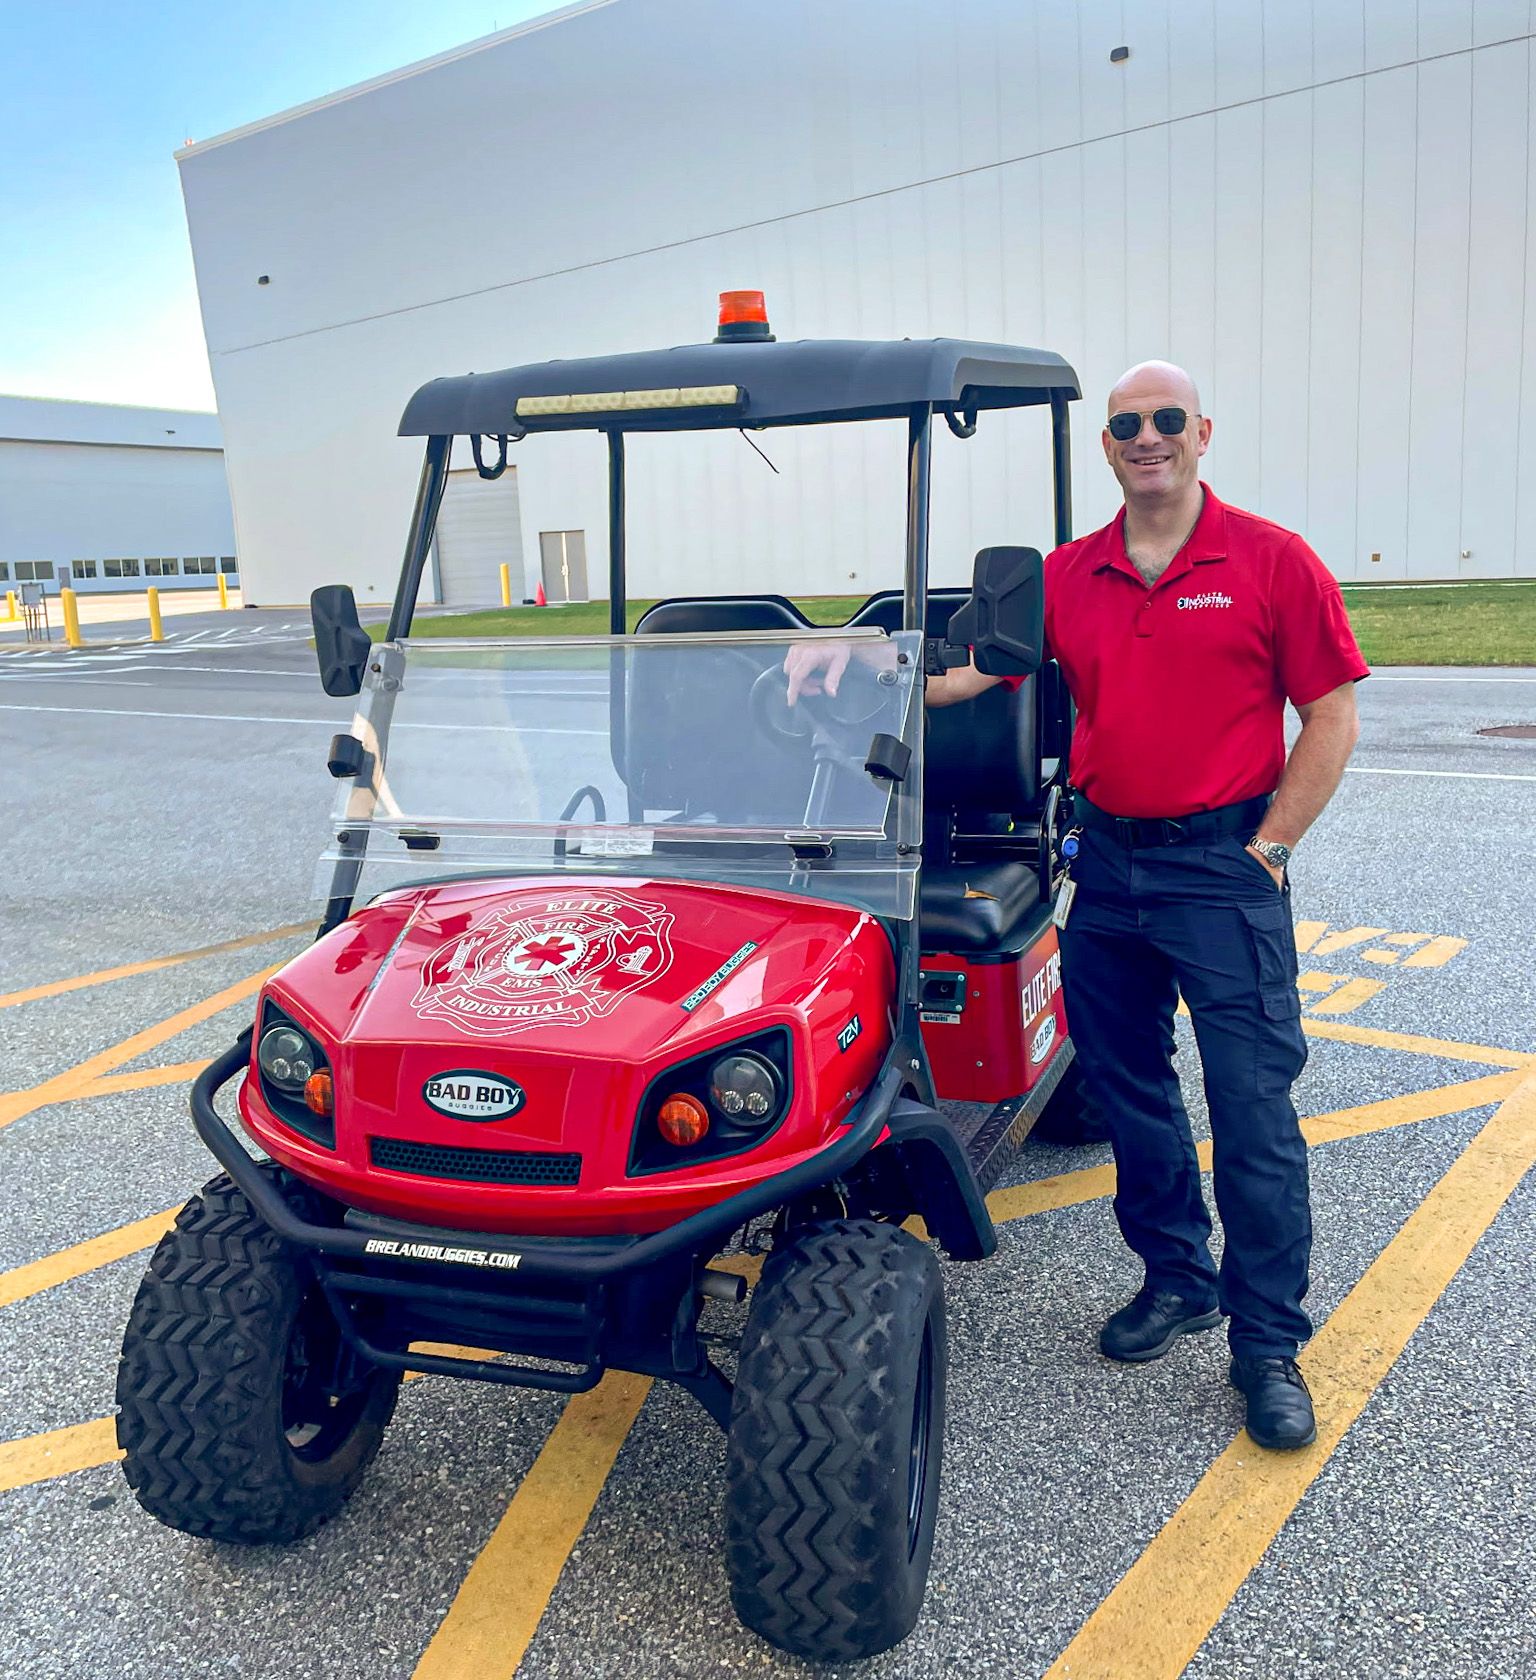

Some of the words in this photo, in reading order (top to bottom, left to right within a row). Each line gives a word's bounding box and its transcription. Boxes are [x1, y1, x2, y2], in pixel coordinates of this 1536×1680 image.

[545, 900, 622, 914] ELITE
[542, 921, 589, 933] FIRE
[575, 936, 607, 976] SAFETY
[500, 977, 543, 988] EMS
[447, 993, 572, 1017] INDUSTRIAL
[1021, 966, 1047, 1029] ELITE
[837, 1016, 860, 1049] 72V
[427, 1081, 471, 1100] BAD
[475, 1087, 522, 1105] BOY
[448, 1102, 492, 1111] BUGGIES
[365, 1239, 522, 1269] BRELANDBUGGIES.COM
